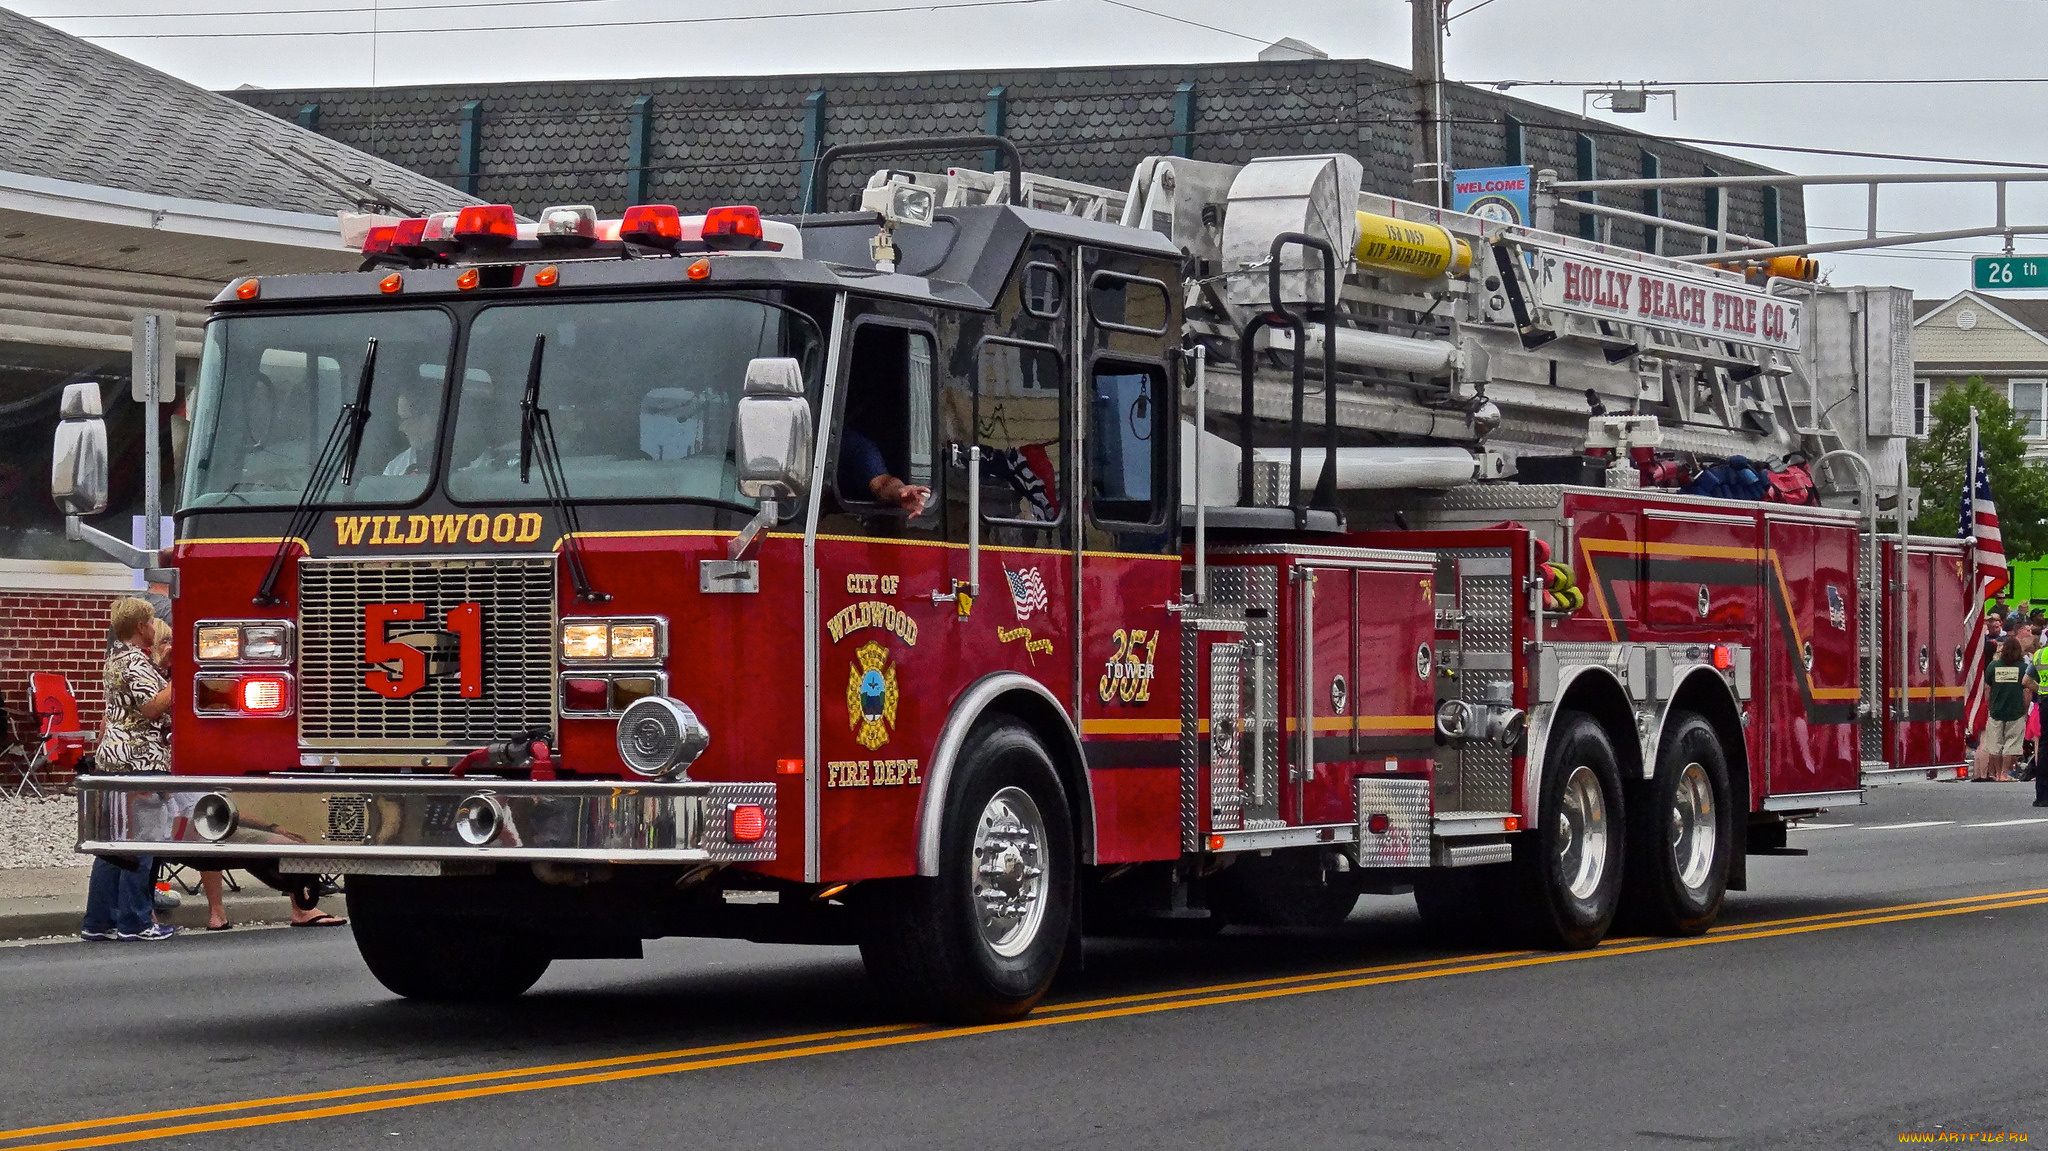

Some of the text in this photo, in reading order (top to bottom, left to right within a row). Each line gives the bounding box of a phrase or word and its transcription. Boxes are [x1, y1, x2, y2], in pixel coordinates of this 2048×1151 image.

[1456, 180, 1525, 194] WELCOME
[1384, 224, 1403, 242] PSI
[1366, 241, 1442, 268] BREATHING AIR
[1988, 262, 2037, 283] 26 th
[1563, 261, 1788, 342] HOLLY BEACH FIRE CO.
[334, 512, 543, 545] WILDWOOD
[846, 573, 900, 595] CITY OF
[826, 600, 918, 646] WILDWOOD
[365, 602, 481, 698] 51
[1105, 662, 1155, 680] TOWER
[827, 759, 922, 787] FIRE DEPT.
